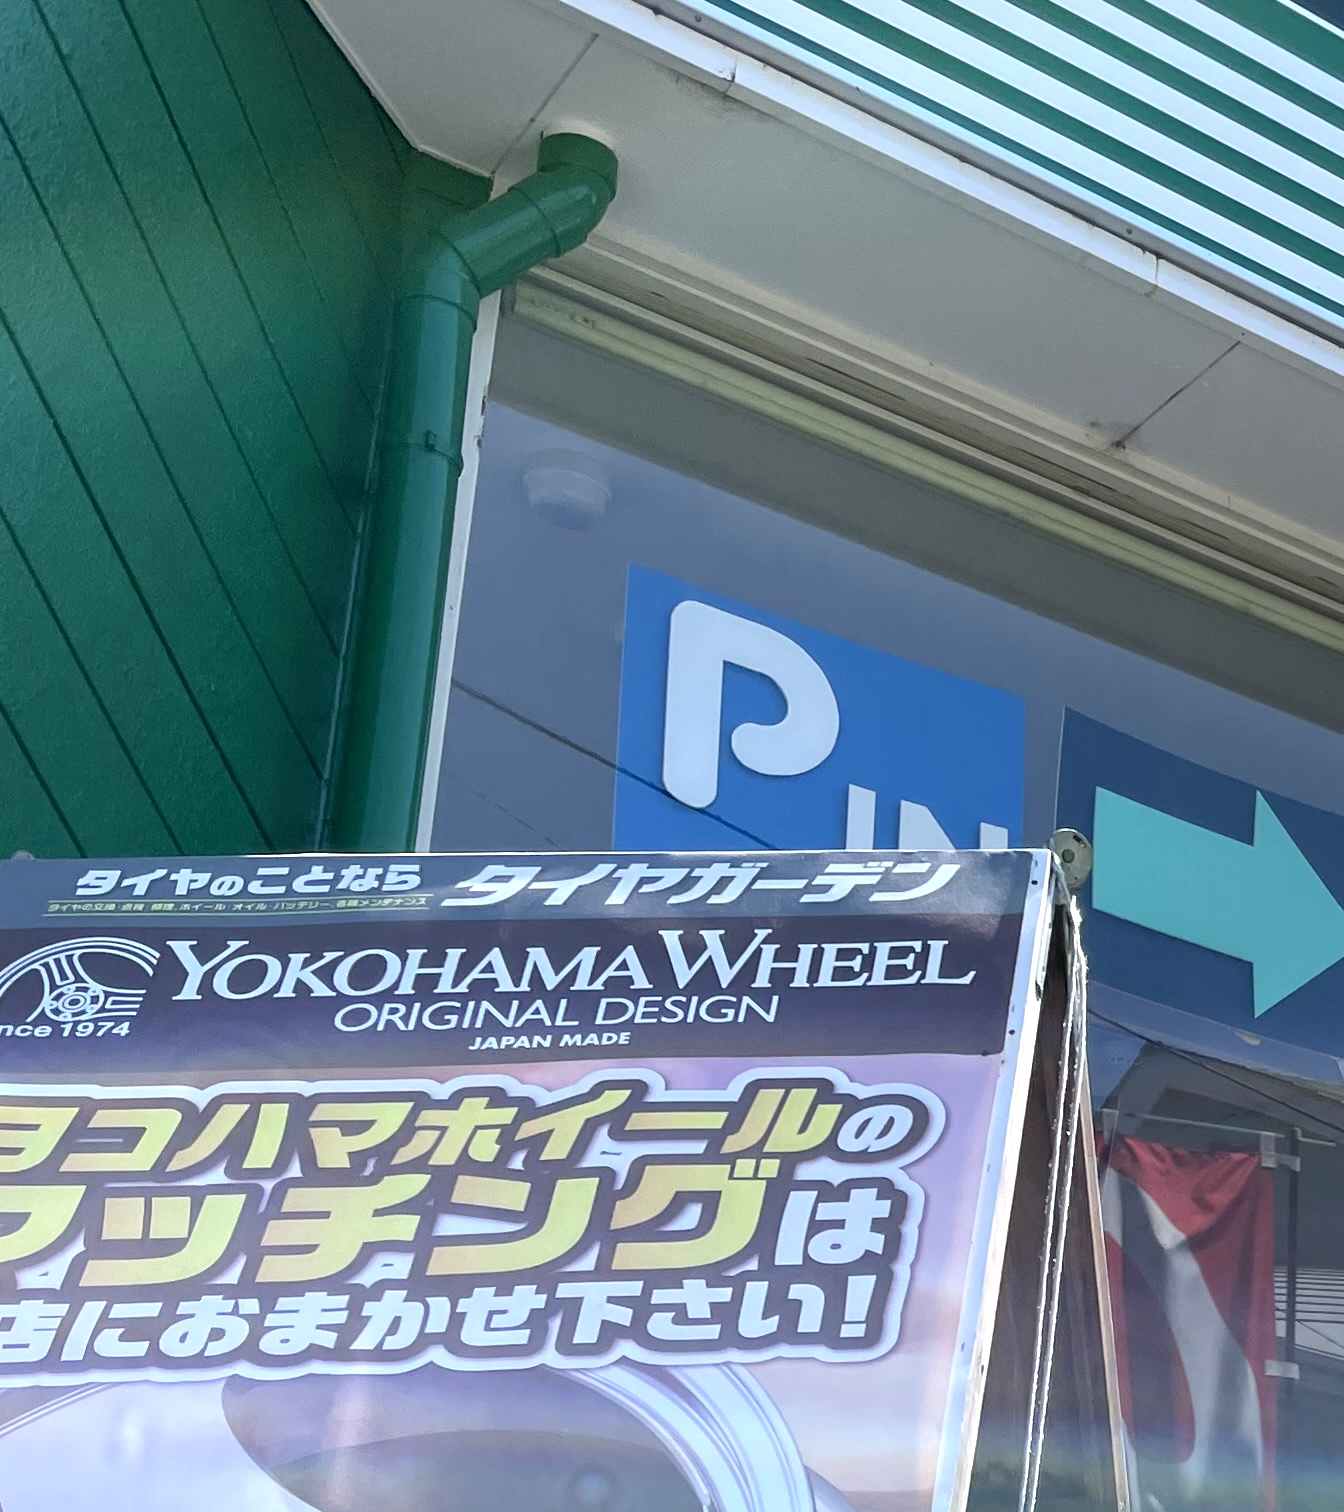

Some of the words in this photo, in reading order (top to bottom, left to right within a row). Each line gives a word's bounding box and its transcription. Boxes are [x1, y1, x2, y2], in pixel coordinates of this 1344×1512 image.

[661, 599, 840, 809] P
[75, 863, 422, 897] タイヤのことなら
[442, 862, 959, 908] タイヤガーデン
[165, 937, 654, 1001] YOKOHAMA
[657, 928, 976, 989] WHEEL
[60, 1020, 131, 1038] 1974
[334, 998, 601, 1033] ORIGINAL
[603, 994, 780, 1027] DESIGN
[468, 1034, 554, 1053] JAPAN
[560, 1030, 633, 1050] MADE
